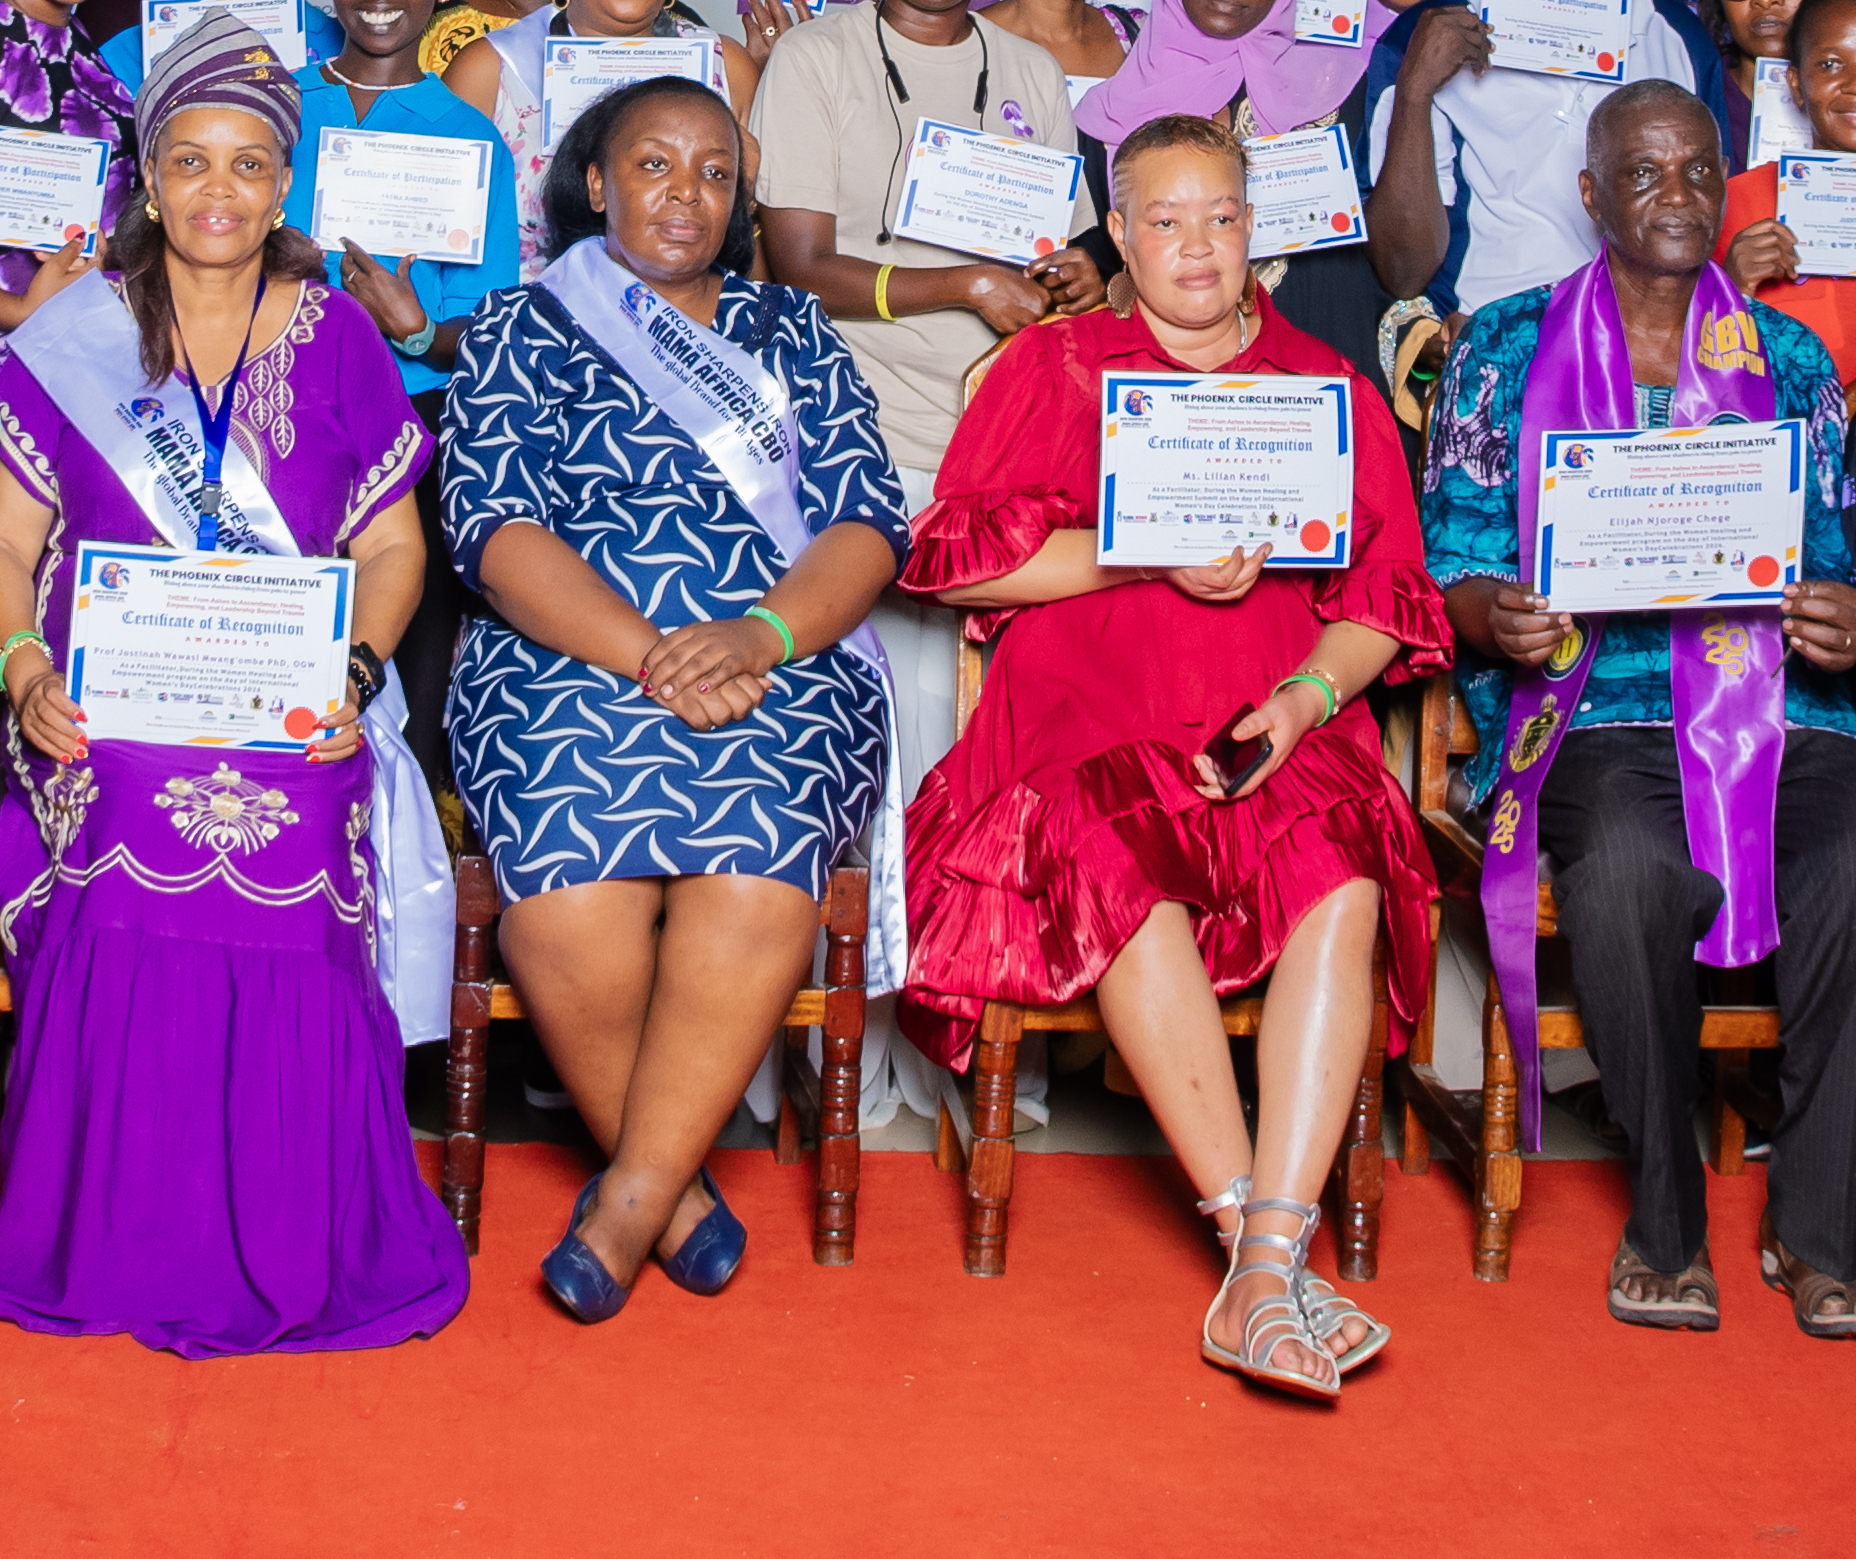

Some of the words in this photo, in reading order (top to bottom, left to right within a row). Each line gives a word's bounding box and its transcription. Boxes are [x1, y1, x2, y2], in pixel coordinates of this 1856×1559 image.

[1696, 345, 1766, 377] CHAMPION
[647, 314, 702, 370] MAMA
[694, 364, 756, 425] AFRICA
[750, 420, 785, 463] CBO
[650, 342, 666, 364] The
[664, 360, 691, 385] global
[689, 379, 722, 410] Brand
[717, 405, 734, 424] for
[661, 306, 698, 341] IRON
[696, 342, 769, 414] SHARPENS
[766, 413, 792, 456] IRON
[1170, 394, 1190, 403] THE
[1190, 394, 1235, 404] PHOENIX
[1238, 395, 1274, 404] CIRCLE
[1274, 396, 1324, 406] INITIATIVE
[167, 419, 203, 456] IRON
[1148, 435, 1215, 450] Certificate
[1218, 436, 1232, 450] of
[1235, 436, 1313, 454] Recognition
[1613, 444, 1633, 454] THE
[1634, 442, 1681, 453] PHOENIX
[1685, 440, 1722, 450] CIRCLE
[1723, 437, 1777, 448] INITIATIVE
[145, 425, 199, 491] MAMA
[1183, 472, 1201, 481] Ms.
[1204, 471, 1236, 481] Lilian
[1239, 472, 1271, 482] Kendi
[1588, 483, 1658, 499] Certificate
[1662, 482, 1676, 496] of
[1678, 480, 1763, 497] Recognition
[1610, 516, 1644, 527] Elijah
[1647, 515, 1693, 527] Njoroge
[1696, 513, 1731, 524] Chege
[149, 568, 171, 578] THE
[172, 570, 221, 582] PHOENIX
[225, 573, 263, 584] CIRCLE
[263, 576, 322, 589] INITIATIVE
[121, 610, 195, 629] Certificate
[199, 616, 214, 630] of
[217, 617, 305, 636] Recognition
[93, 647, 116, 657] Prof
[118, 648, 161, 659] Jostinah
